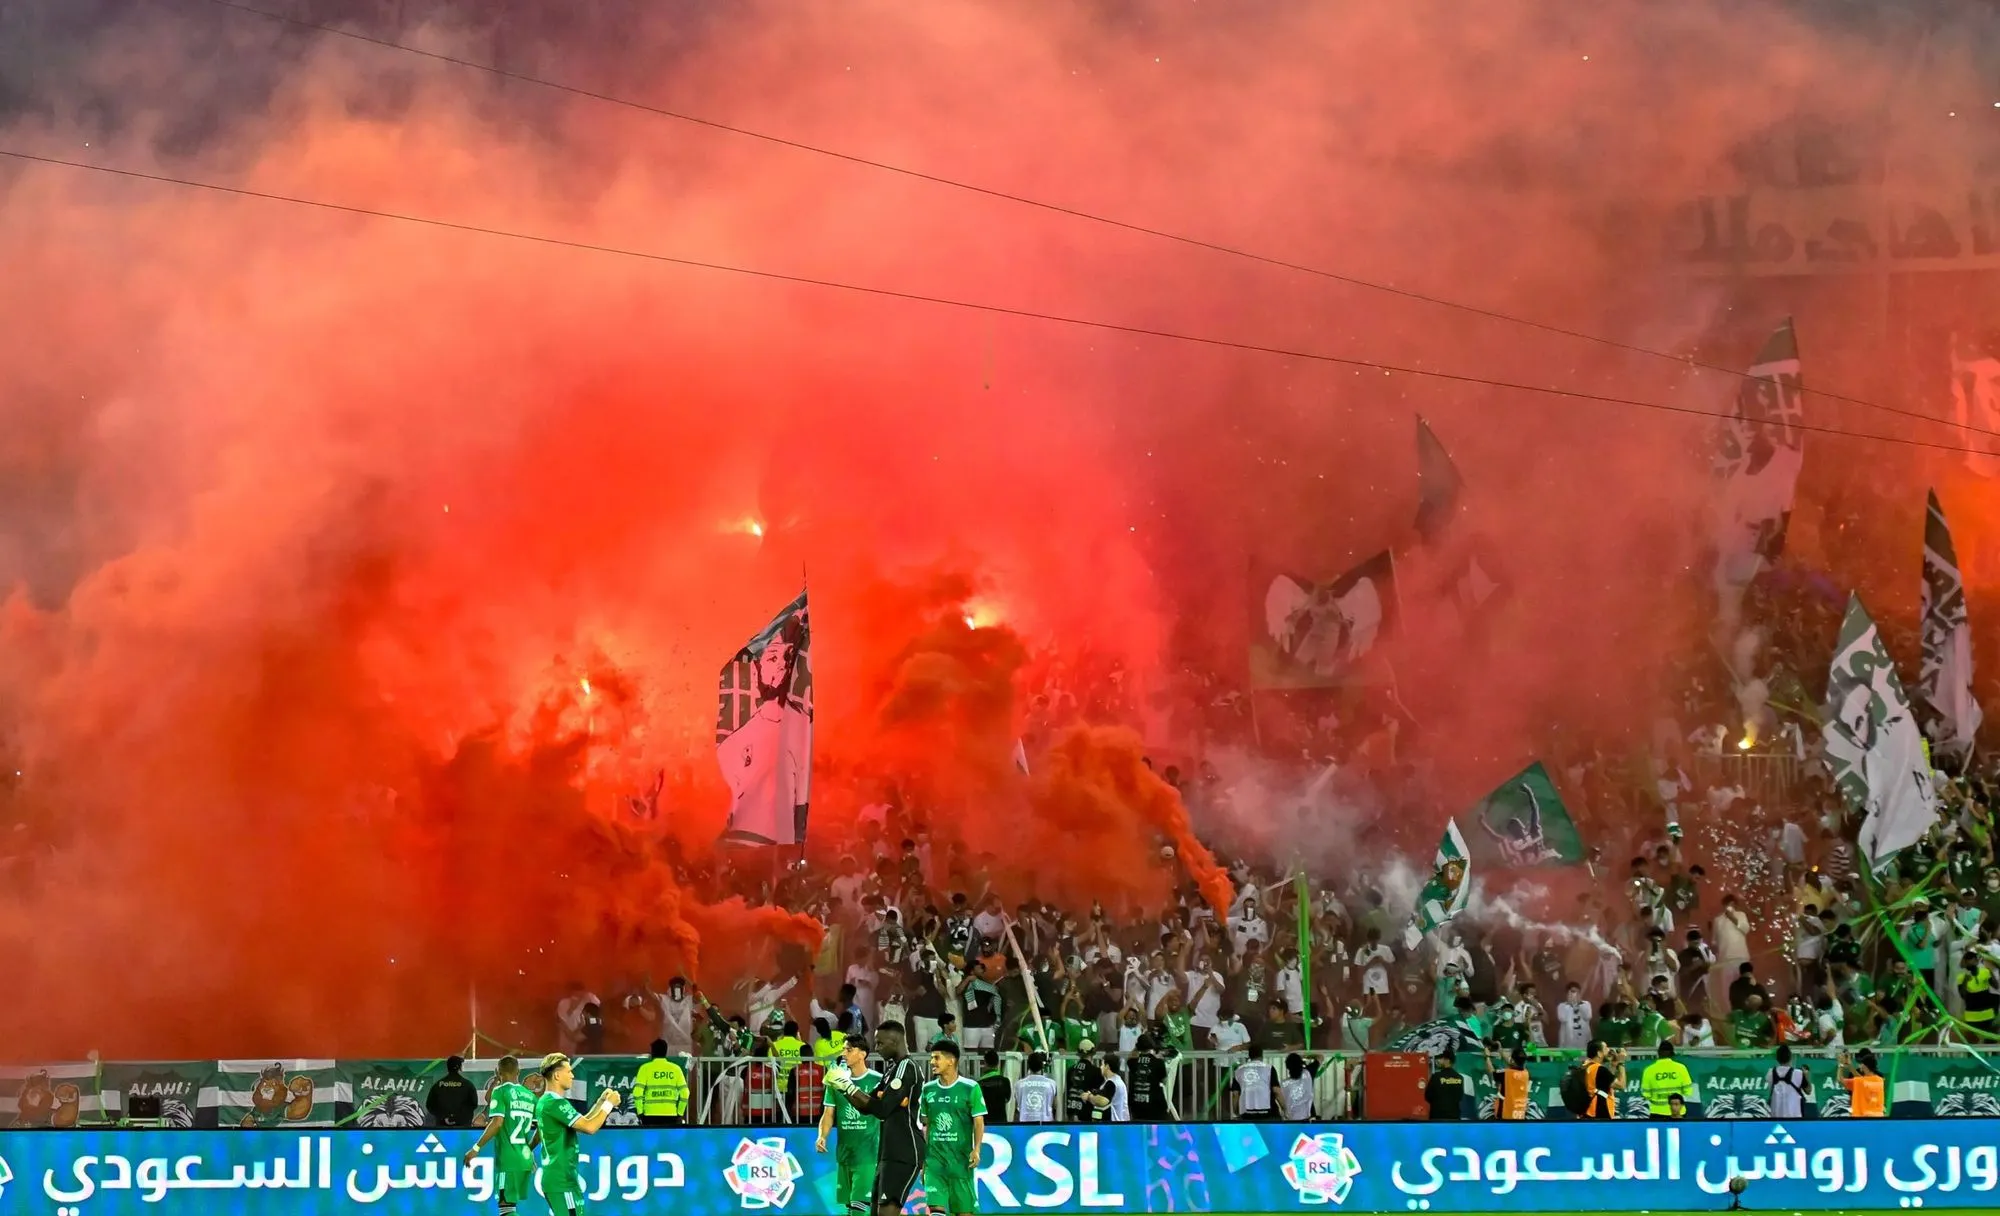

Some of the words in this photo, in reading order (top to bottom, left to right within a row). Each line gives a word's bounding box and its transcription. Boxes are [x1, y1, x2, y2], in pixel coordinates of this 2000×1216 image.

[780, 1049, 799, 1057] EPIC
[653, 1071, 675, 1080] EPIC
[1440, 1077, 1462, 1085] Police
[1655, 1071, 1677, 1081] EPIC
[439, 1080, 462, 1088] Police
[1695, 1123, 1868, 1194] روشن
[750, 1166, 776, 1179] RSL
[973, 1131, 1124, 1208] RSL
[1308, 1161, 1335, 1174] RSL
[1391, 1127, 1681, 1210] السعودي
[43, 1137, 331, 1216] السعودي
